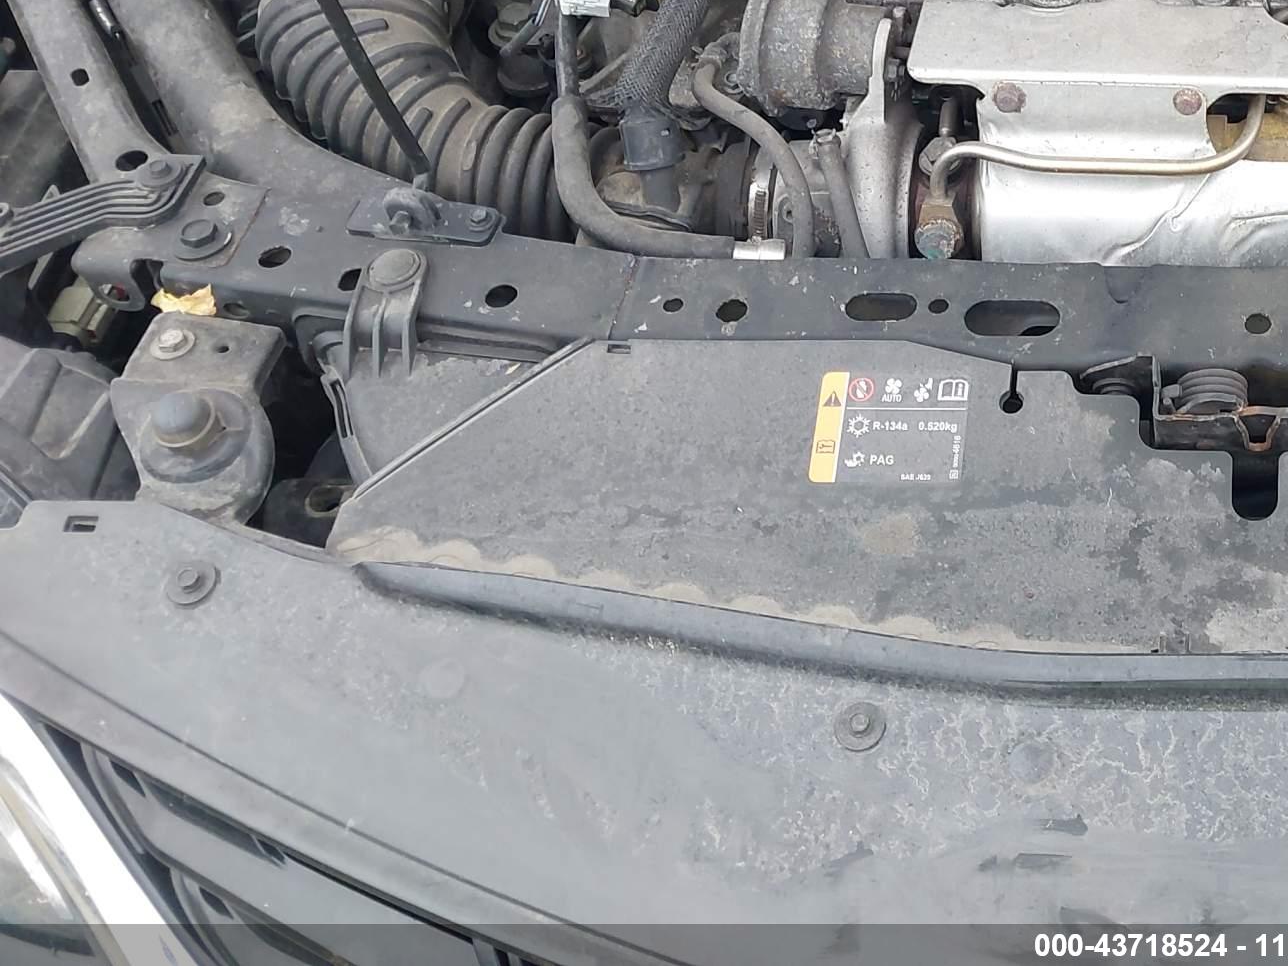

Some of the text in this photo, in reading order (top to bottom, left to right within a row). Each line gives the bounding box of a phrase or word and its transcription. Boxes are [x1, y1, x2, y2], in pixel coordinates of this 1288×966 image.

[881, 394, 902, 403] AUTO
[872, 421, 909, 431] R-134a
[869, 454, 895, 465] PAG
